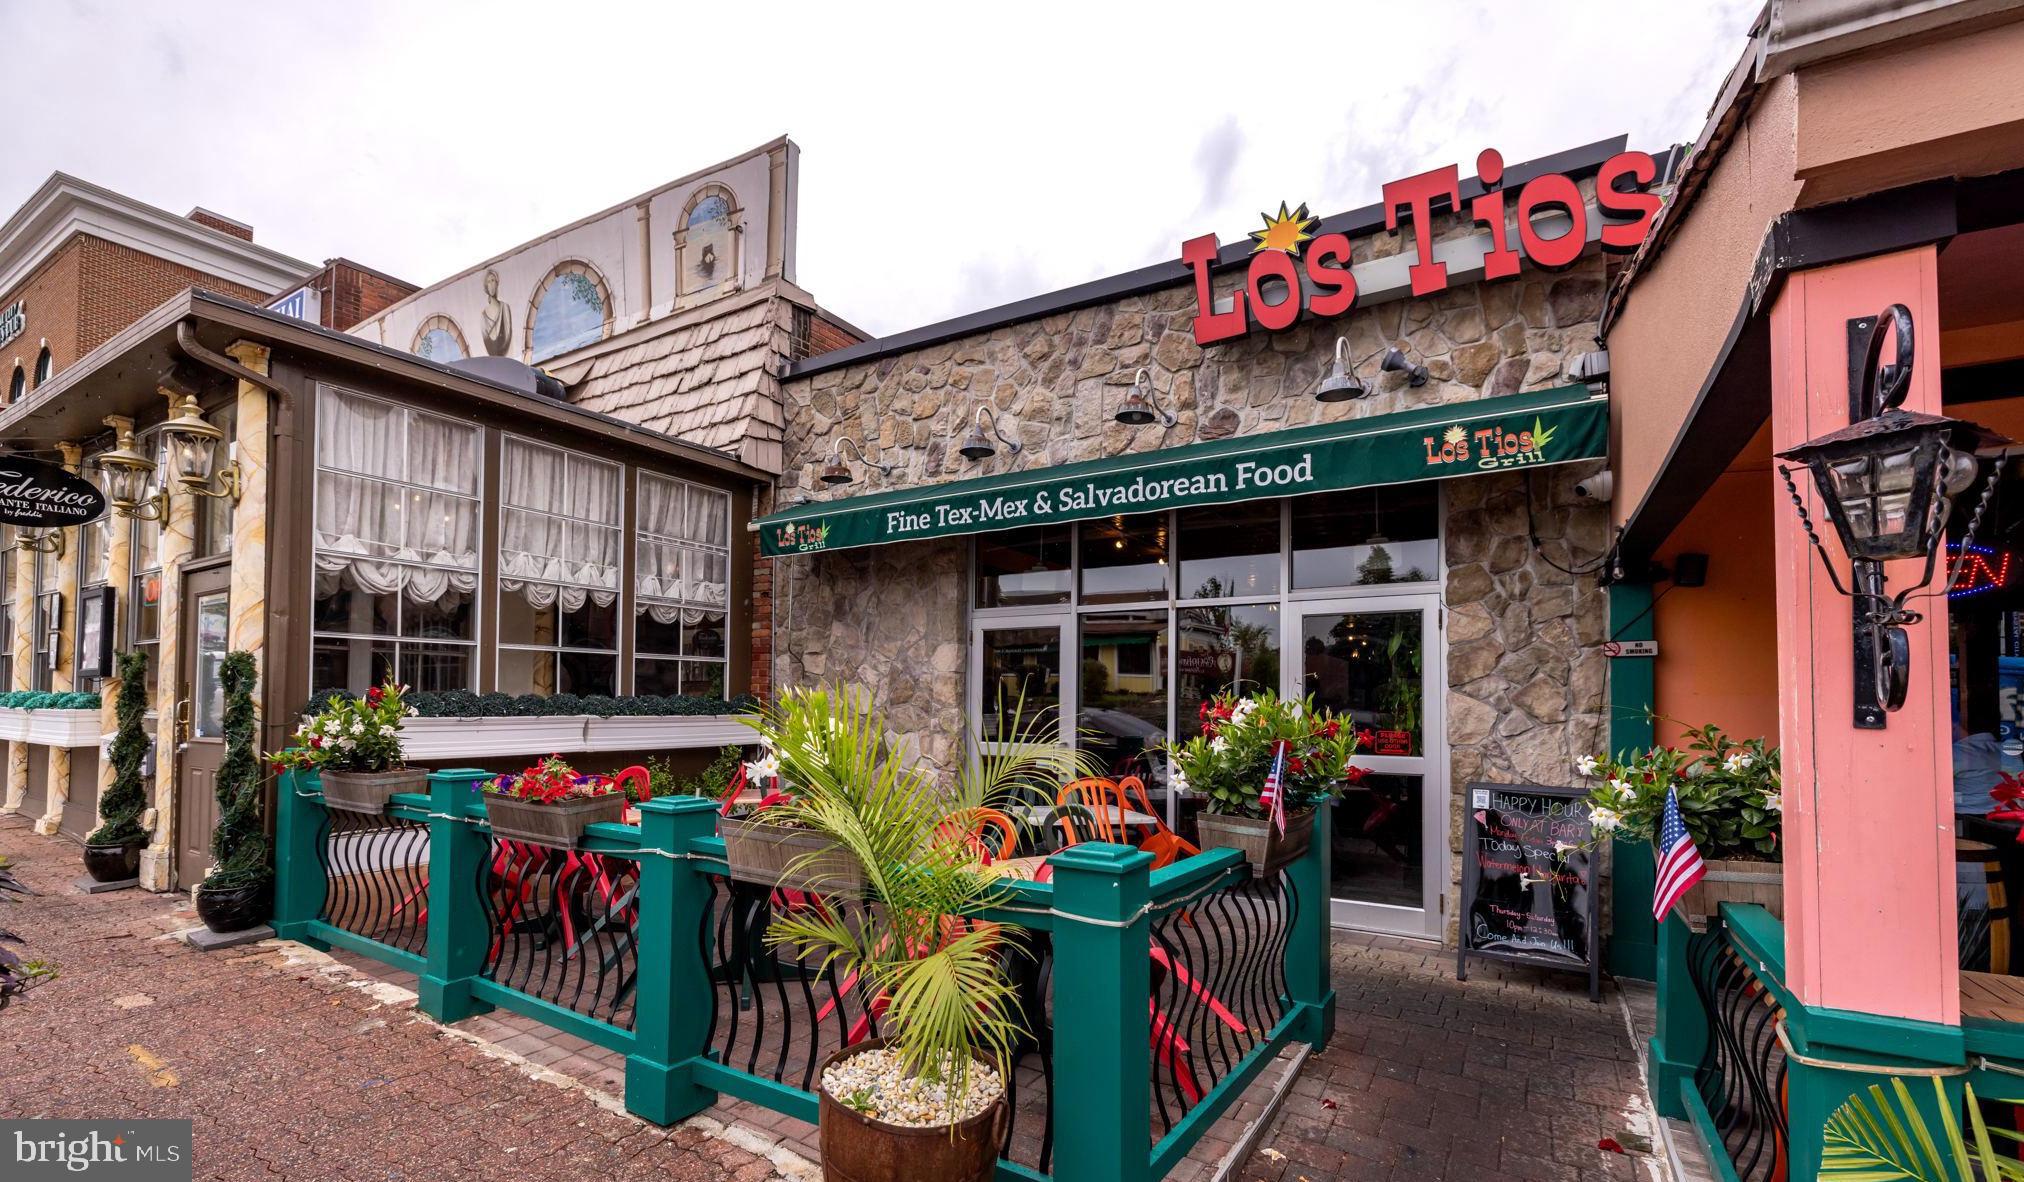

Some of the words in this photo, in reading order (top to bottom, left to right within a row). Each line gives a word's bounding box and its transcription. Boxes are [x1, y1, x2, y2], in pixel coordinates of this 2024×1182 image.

[1181, 231, 1358, 346] Los
[1382, 147, 1665, 297] Tios
[1424, 436, 1470, 465] Los
[1474, 426, 1534, 459] Tios
[1478, 451, 1546, 469] Grill
[886, 511, 931, 534] Fine
[935, 497, 1028, 527] Tex-Mex
[1033, 490, 1052, 514] &
[1058, 472, 1228, 511] Salvadorean
[1235, 453, 1314, 490] Food
[4, 508, 14, 516] by
[35, 502, 87, 516] ITALIANO
[776, 528, 796, 547] Los
[798, 541, 826, 551] Grill
[1492, 793, 1537, 815] HAPPY
[1541, 797, 1584, 818] HOUR
[1500, 814, 1529, 831] ONLY
[1531, 819, 1547, 833] AT
[1478, 837, 1521, 859] Today
[1476, 924, 1508, 939] Come
[1511, 934, 1527, 945] And
